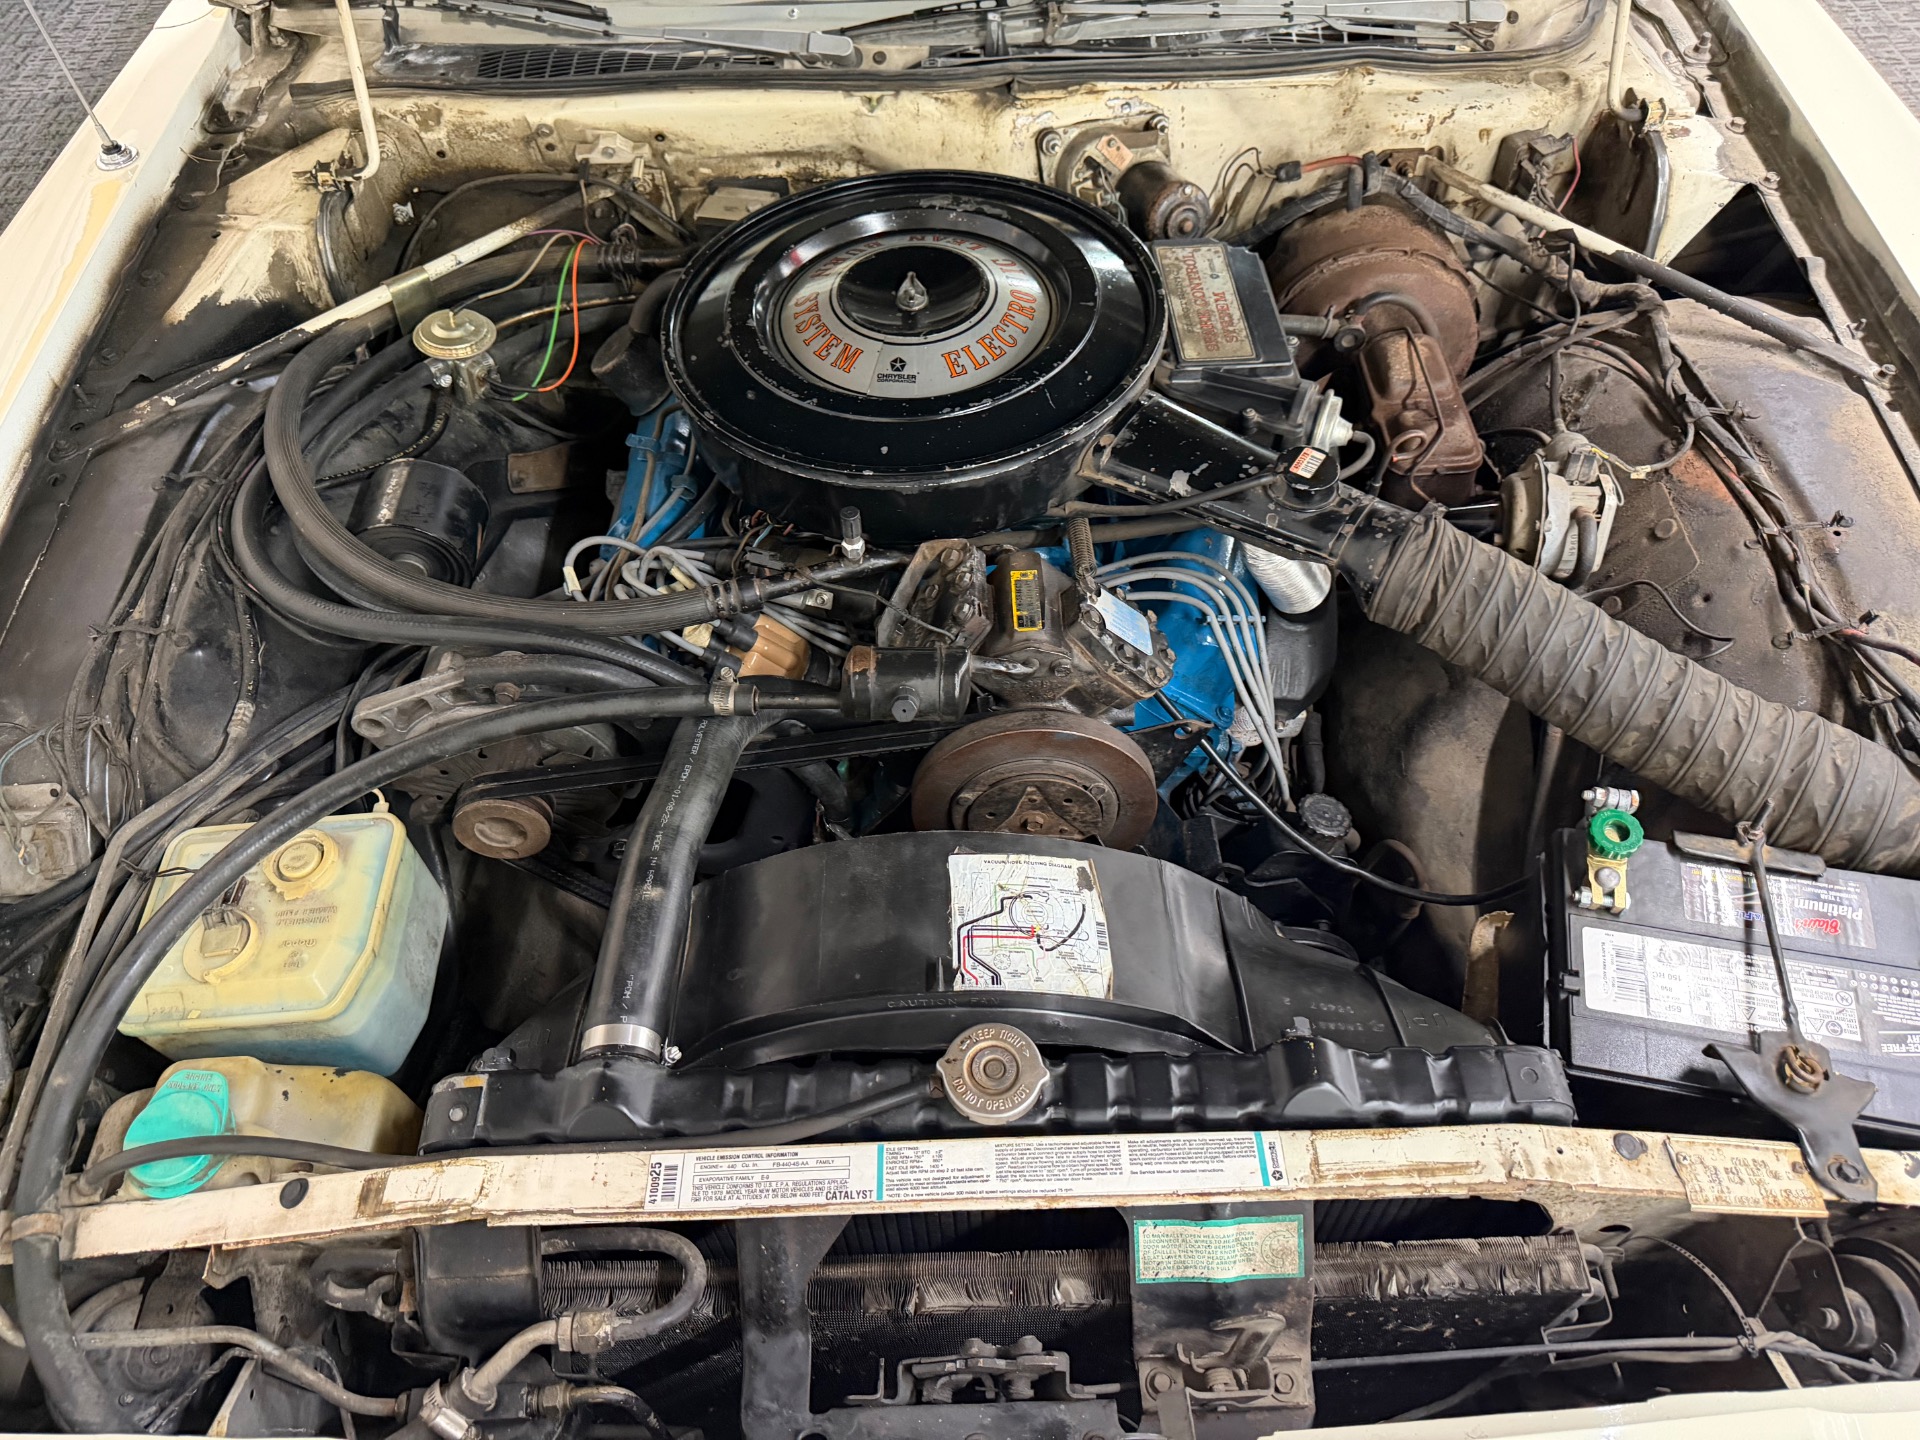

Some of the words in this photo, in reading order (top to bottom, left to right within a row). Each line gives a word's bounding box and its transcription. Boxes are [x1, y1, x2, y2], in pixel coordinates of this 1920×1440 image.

[1182, 252, 1210, 307] CONTROL
[793, 291, 864, 374] SYSTEM
[692, 719, 708, 755] POLYESTER
[1794, 898, 1863, 921] Platinum
[1794, 918, 1842, 936] Blain's
[887, 998, 957, 1008] CAUTION
[970, 997, 1000, 1005] FAN
[971, 1028, 995, 1043] KEEP
[999, 1029, 1025, 1048] TIGHT
[952, 1078, 966, 1092] DO
[962, 1090, 984, 1108] NOT
[986, 1098, 1012, 1111] OPEN
[1013, 1084, 1030, 1104] HOT
[646, 1161, 662, 1204] 4100925
[825, 1189, 874, 1200] CATALYST
